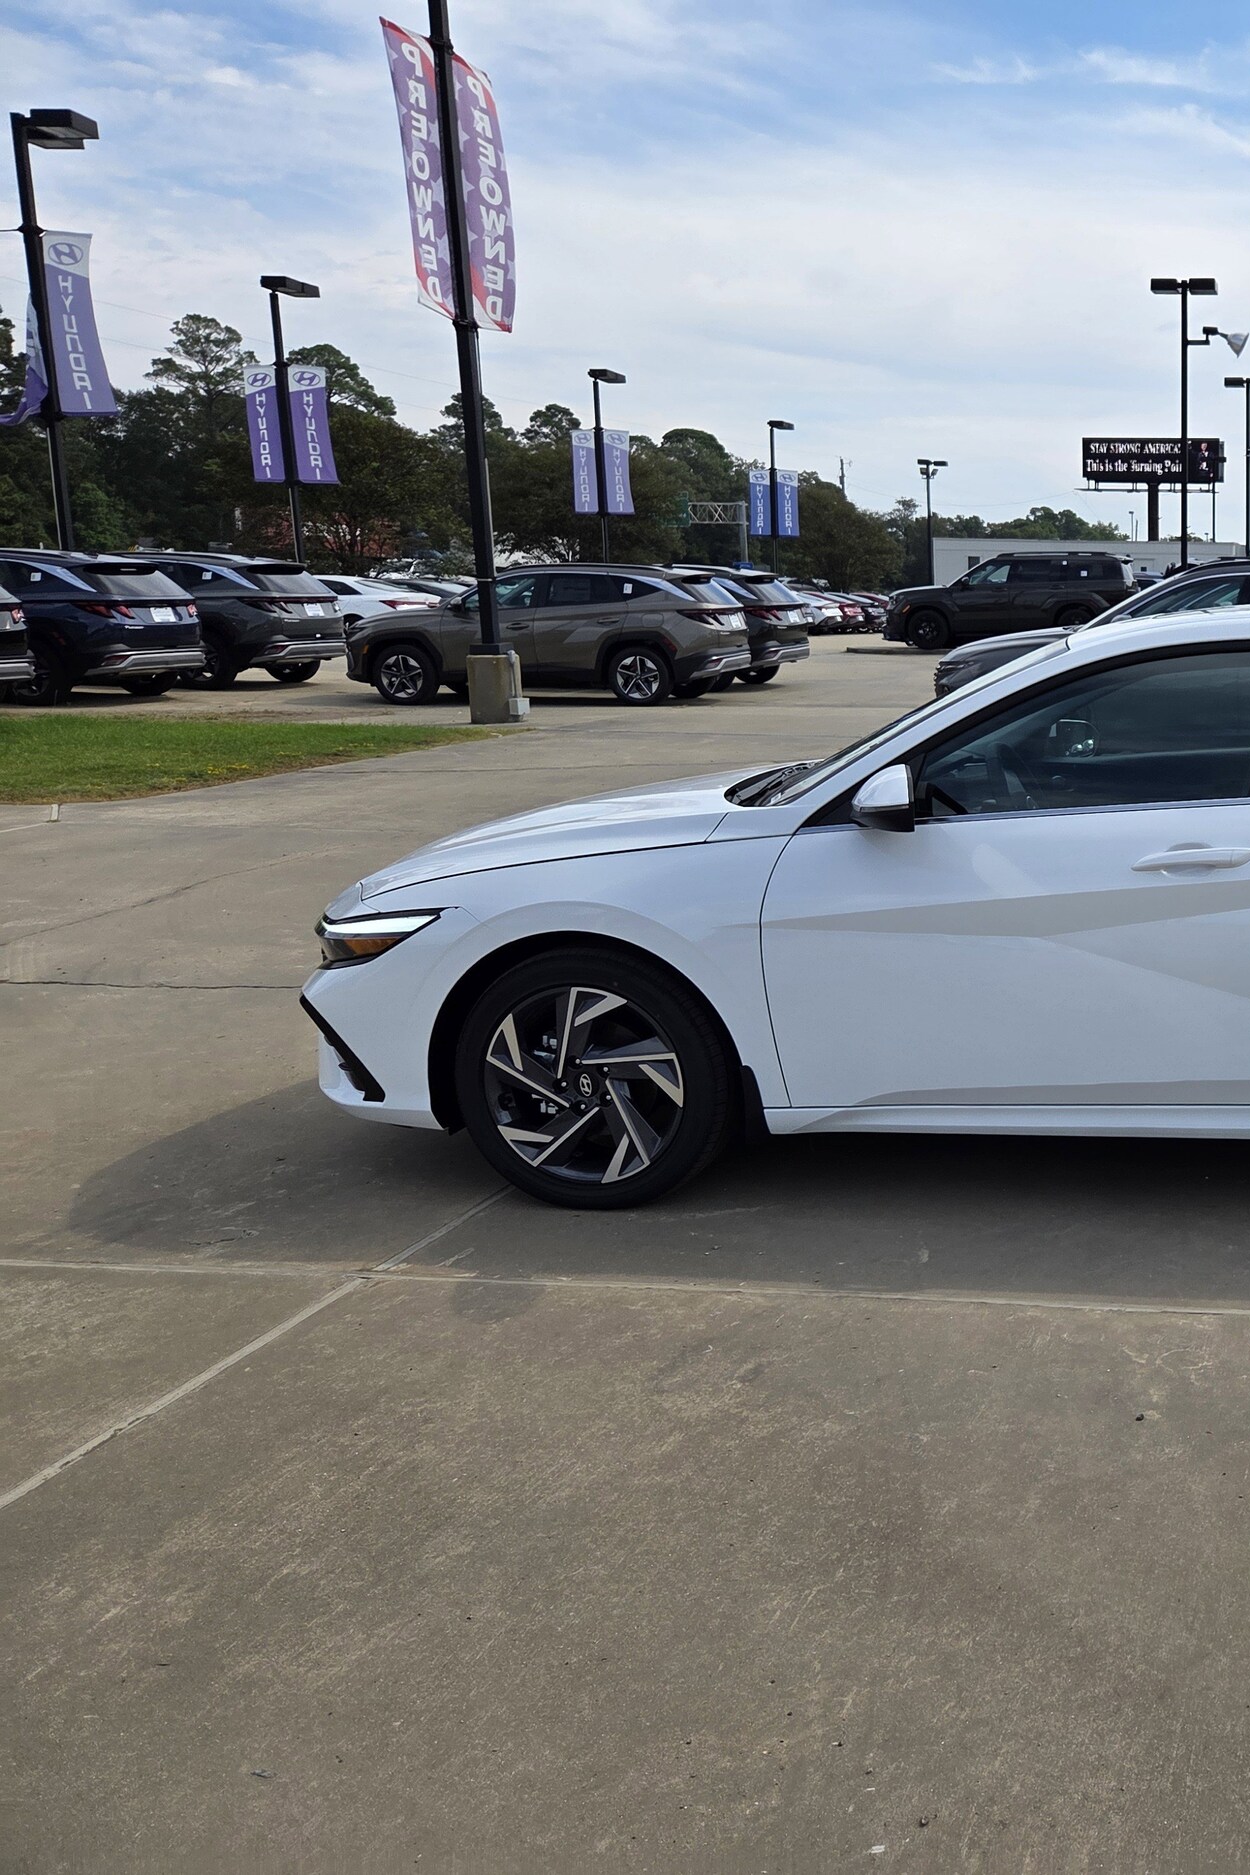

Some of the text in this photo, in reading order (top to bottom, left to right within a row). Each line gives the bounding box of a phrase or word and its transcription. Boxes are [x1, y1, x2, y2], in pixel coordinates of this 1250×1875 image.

[57, 274, 93, 410] HYUNDAI
[255, 392, 272, 479] HYUNDAI
[302, 391, 323, 481] HYUNDAI
[1086, 459, 1103, 472] This
[1105, 459, 1113, 472] is
[1114, 459, 1128, 472] the
[1130, 459, 1163, 475] Turning
[1090, 442, 1108, 454] STAY
[1109, 442, 1141, 454] STRONG
[579, 447, 590, 512] HYUNDAI
[613, 447, 625, 512] HYUNDAI
[756, 484, 764, 535] HYUNDAI
[784, 485, 793, 535] HYUNDAI
